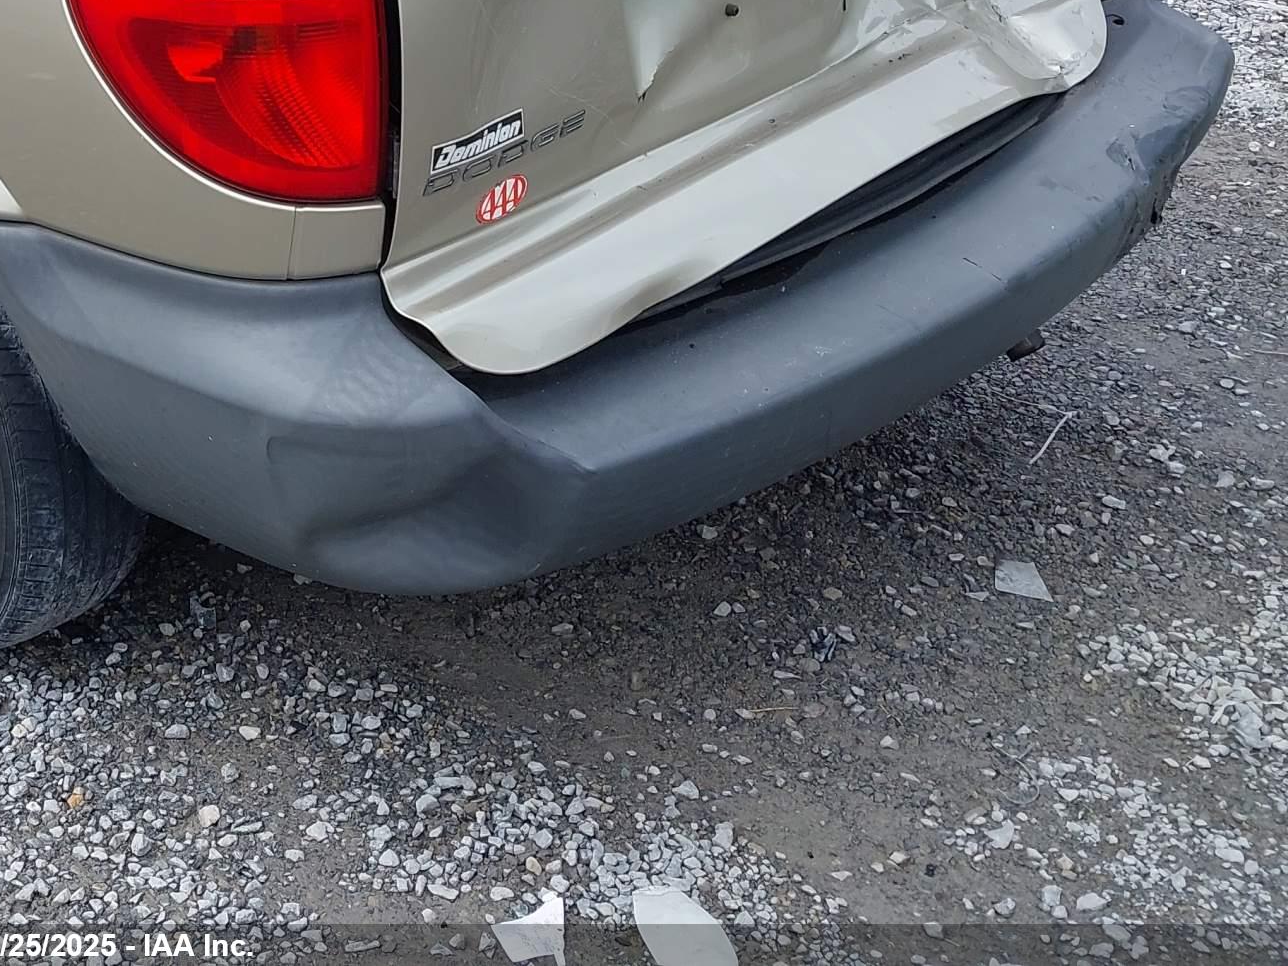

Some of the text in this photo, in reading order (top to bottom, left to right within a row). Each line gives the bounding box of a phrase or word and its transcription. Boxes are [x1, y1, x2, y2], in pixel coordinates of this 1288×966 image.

[423, 109, 586, 197] DODGE
[434, 119, 522, 170] Dominion
[477, 176, 527, 222] AAA
